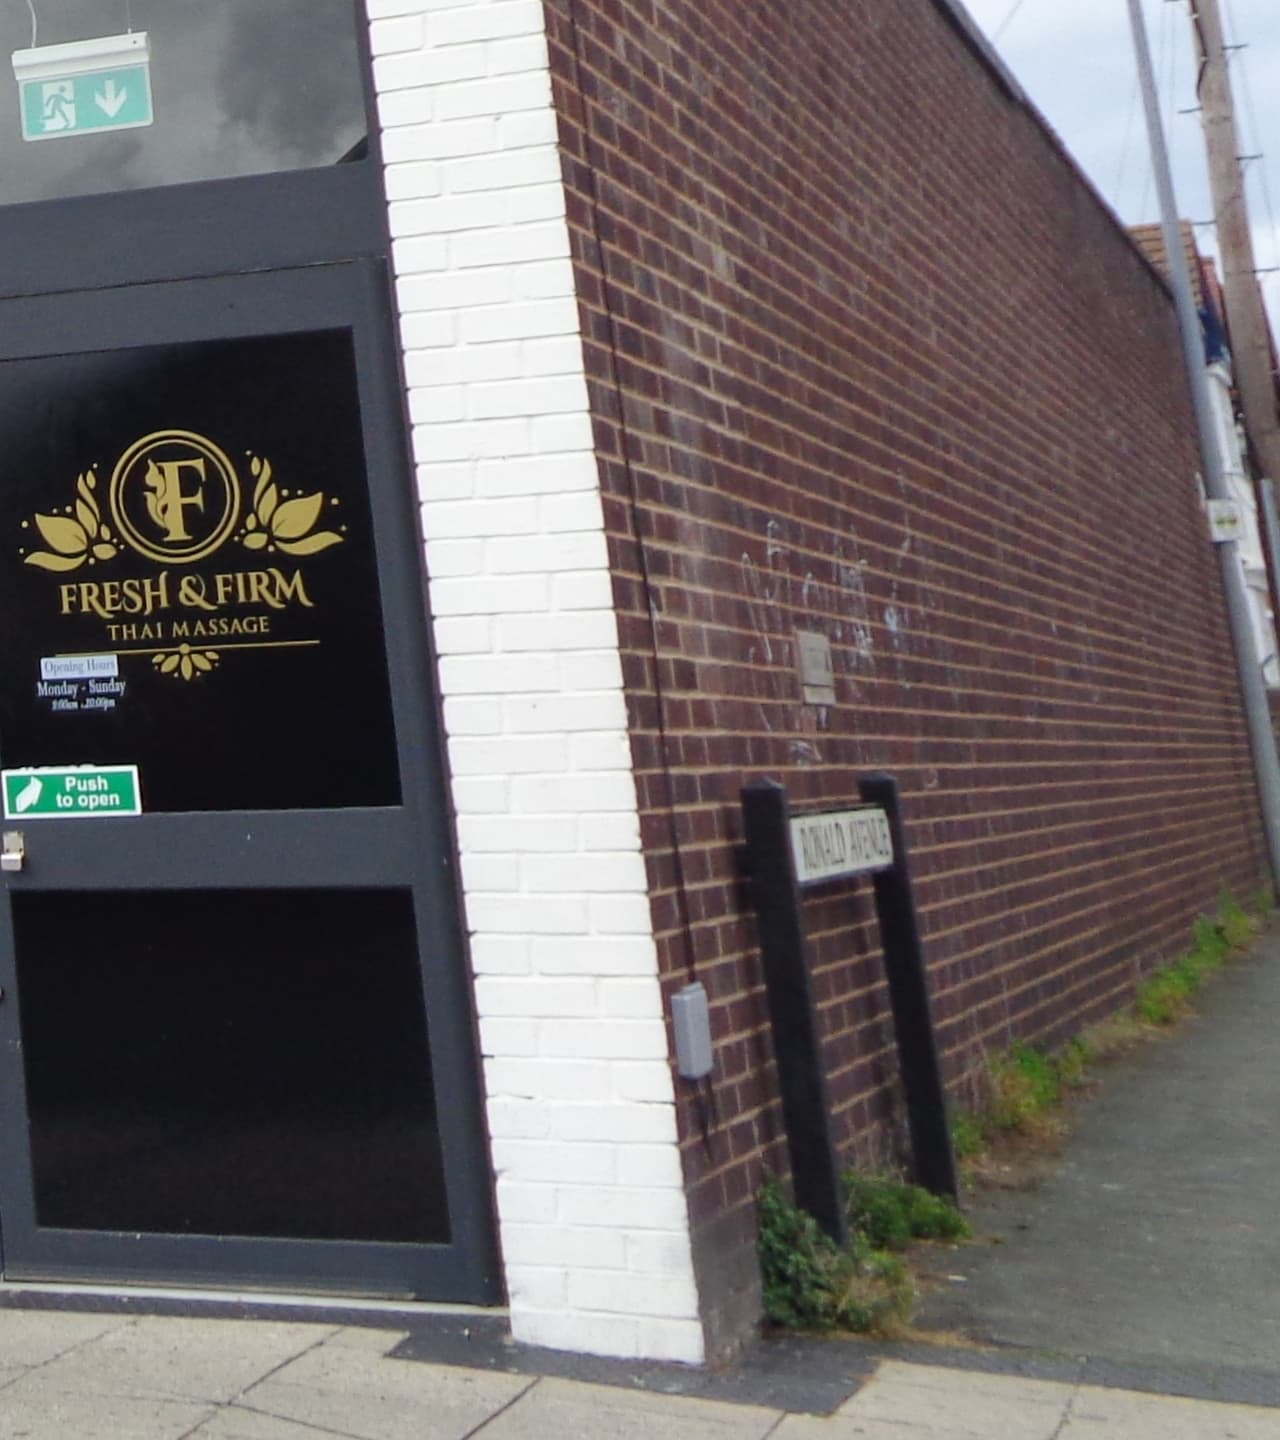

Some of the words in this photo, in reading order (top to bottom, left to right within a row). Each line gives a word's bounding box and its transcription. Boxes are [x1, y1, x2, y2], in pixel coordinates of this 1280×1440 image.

[60, 570, 170, 619] FRESH
[178, 573, 218, 610] &
[215, 567, 315, 609] FIRM
[106, 623, 163, 641] THAI
[172, 616, 271, 638] MASSAGE
[44, 660, 85, 673] Opening
[87, 658, 115, 671] Hours
[37, 680, 78, 698] Monday
[88, 677, 126, 696] Sunday
[65, 775, 108, 792] Push
[56, 794, 73, 808] to
[78, 793, 120, 809] open
